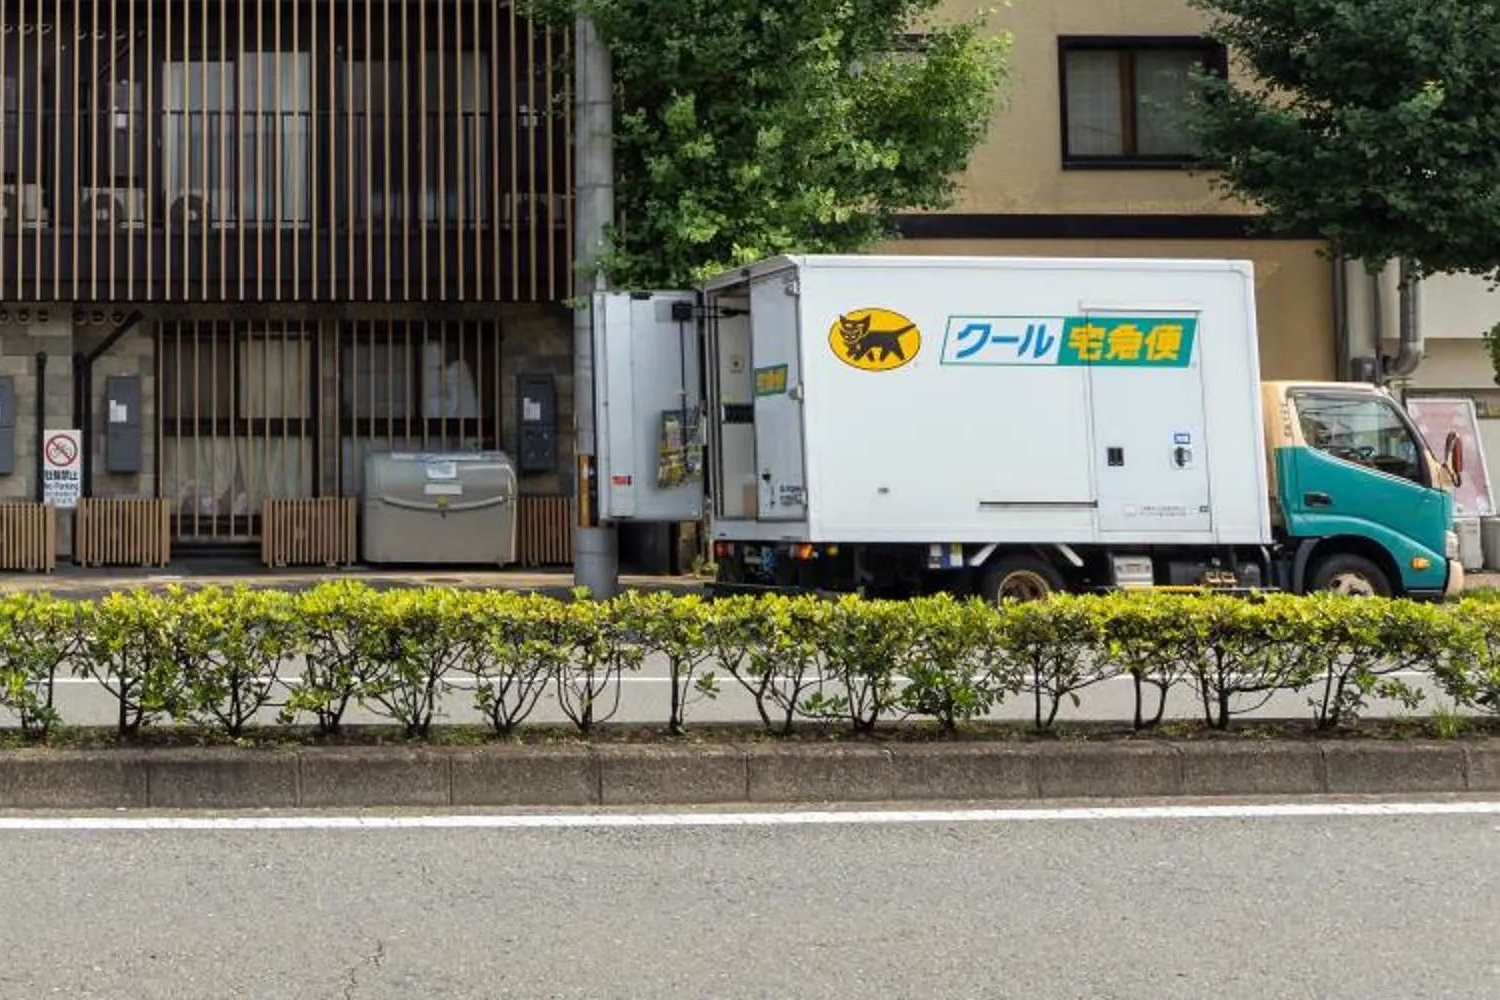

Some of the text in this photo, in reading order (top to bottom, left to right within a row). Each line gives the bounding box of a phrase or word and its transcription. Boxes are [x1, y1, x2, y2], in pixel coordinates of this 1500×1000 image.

[956, 323, 1183, 361] クール宅急便
